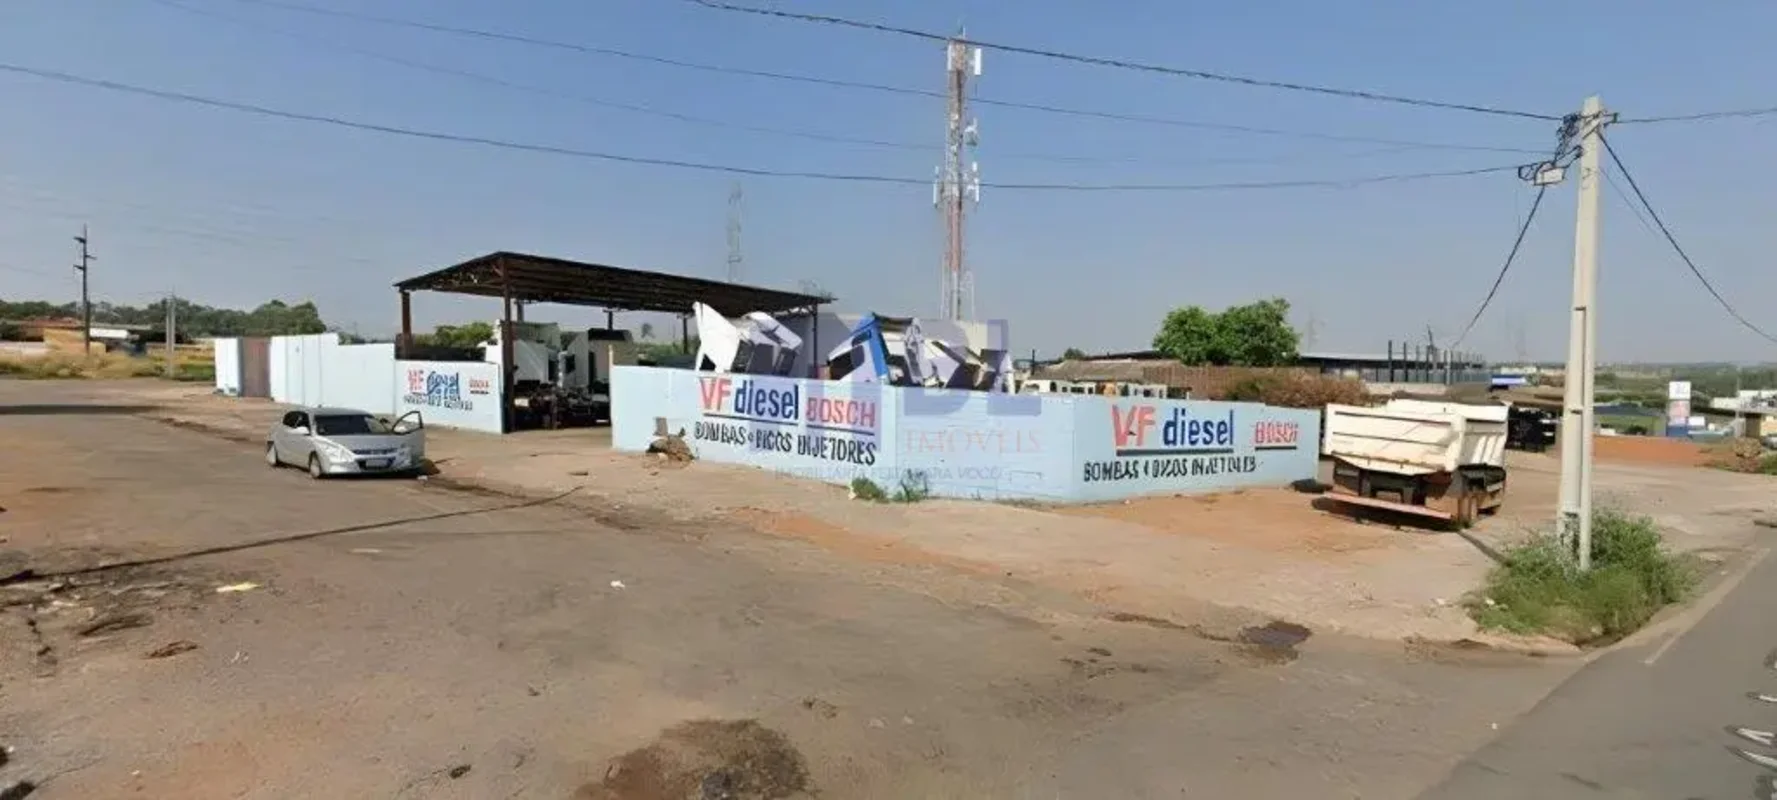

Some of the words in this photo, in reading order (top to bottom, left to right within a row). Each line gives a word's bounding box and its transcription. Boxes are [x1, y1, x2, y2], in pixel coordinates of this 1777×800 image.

[699, 376, 732, 412] VF
[734, 379, 799, 420] diesel
[805, 397, 875, 427] BOSCH
[694, 421, 746, 445] BOMBAS
[1111, 404, 1156, 447] VF
[1162, 407, 1234, 447] diesel
[1083, 460, 1139, 482] BOMBAS
